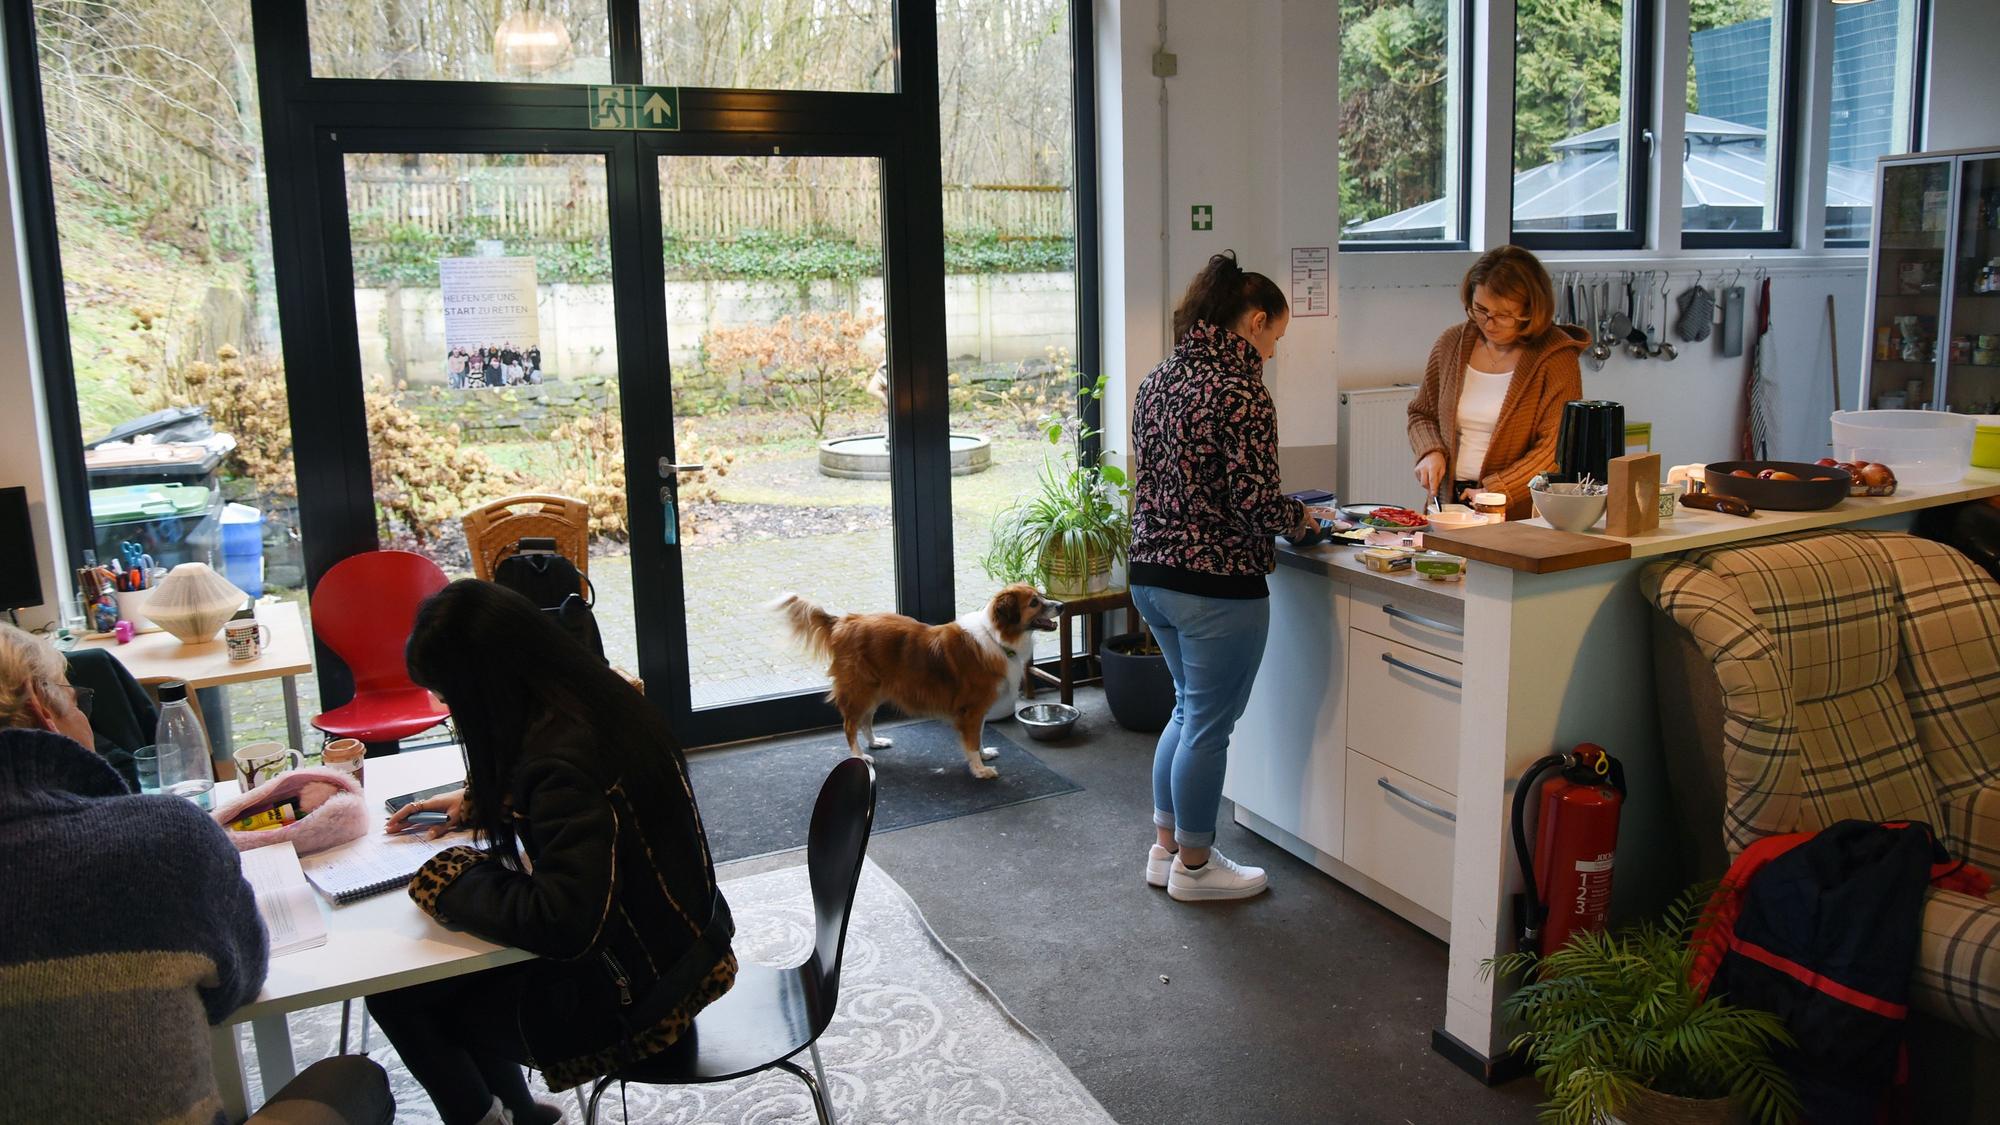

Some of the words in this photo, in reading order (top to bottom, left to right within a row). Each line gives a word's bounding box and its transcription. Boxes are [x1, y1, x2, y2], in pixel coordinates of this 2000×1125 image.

[444, 294, 480, 303] HELFEN
[444, 307, 475, 316] START
[479, 306, 490, 314] ZU
[492, 305, 528, 314] RETTEN
[1580, 873, 1587, 887] 1
[1576, 887, 1587, 900] 2
[1575, 901, 1585, 914] 3
